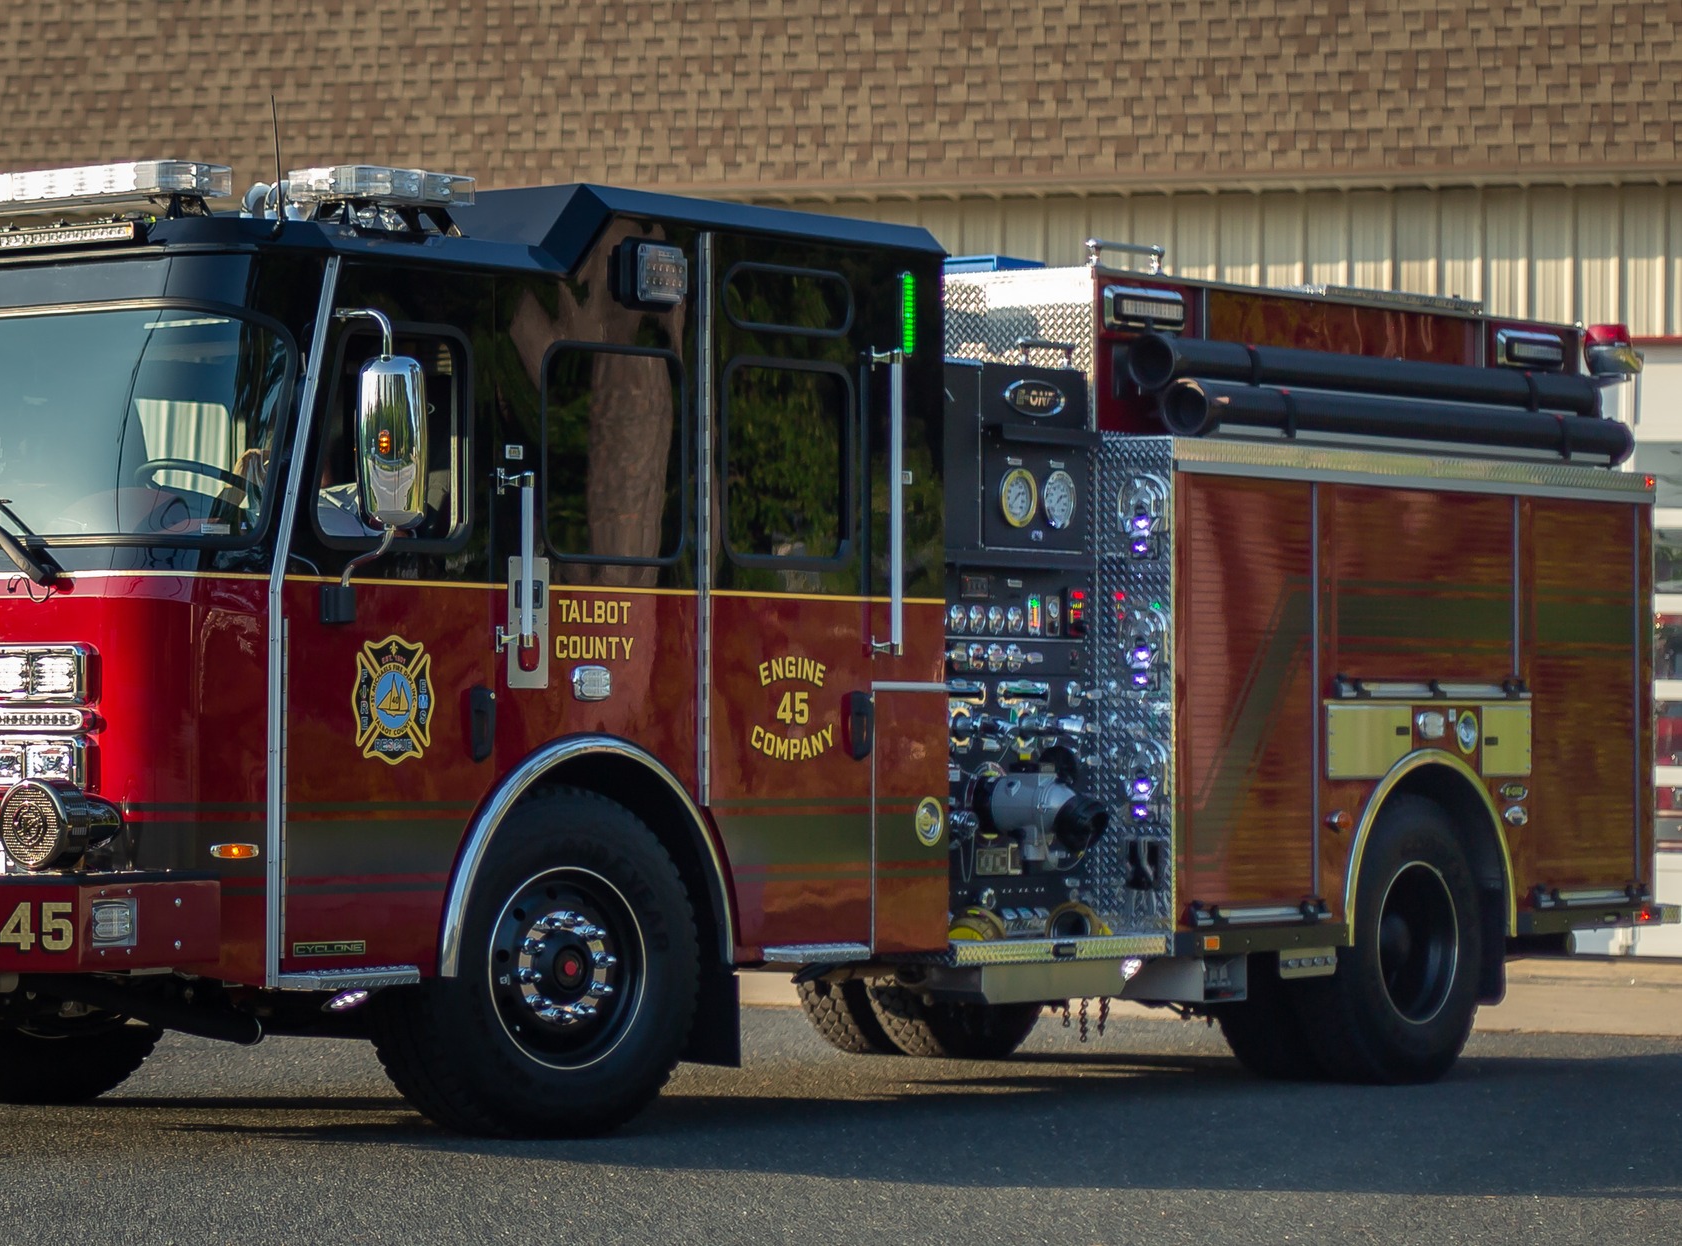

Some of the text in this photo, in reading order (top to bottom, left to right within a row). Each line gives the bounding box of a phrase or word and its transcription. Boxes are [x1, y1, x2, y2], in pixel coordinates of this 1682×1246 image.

[558, 599, 631, 625] TALBOT
[555, 635, 634, 660] COUNTY
[759, 656, 826, 688] ENGINE
[776, 691, 810, 725] 45
[374, 738, 413, 752] RESCUE
[751, 723, 834, 761] COMPANY
[295, 943, 364, 954] CYCLONE
